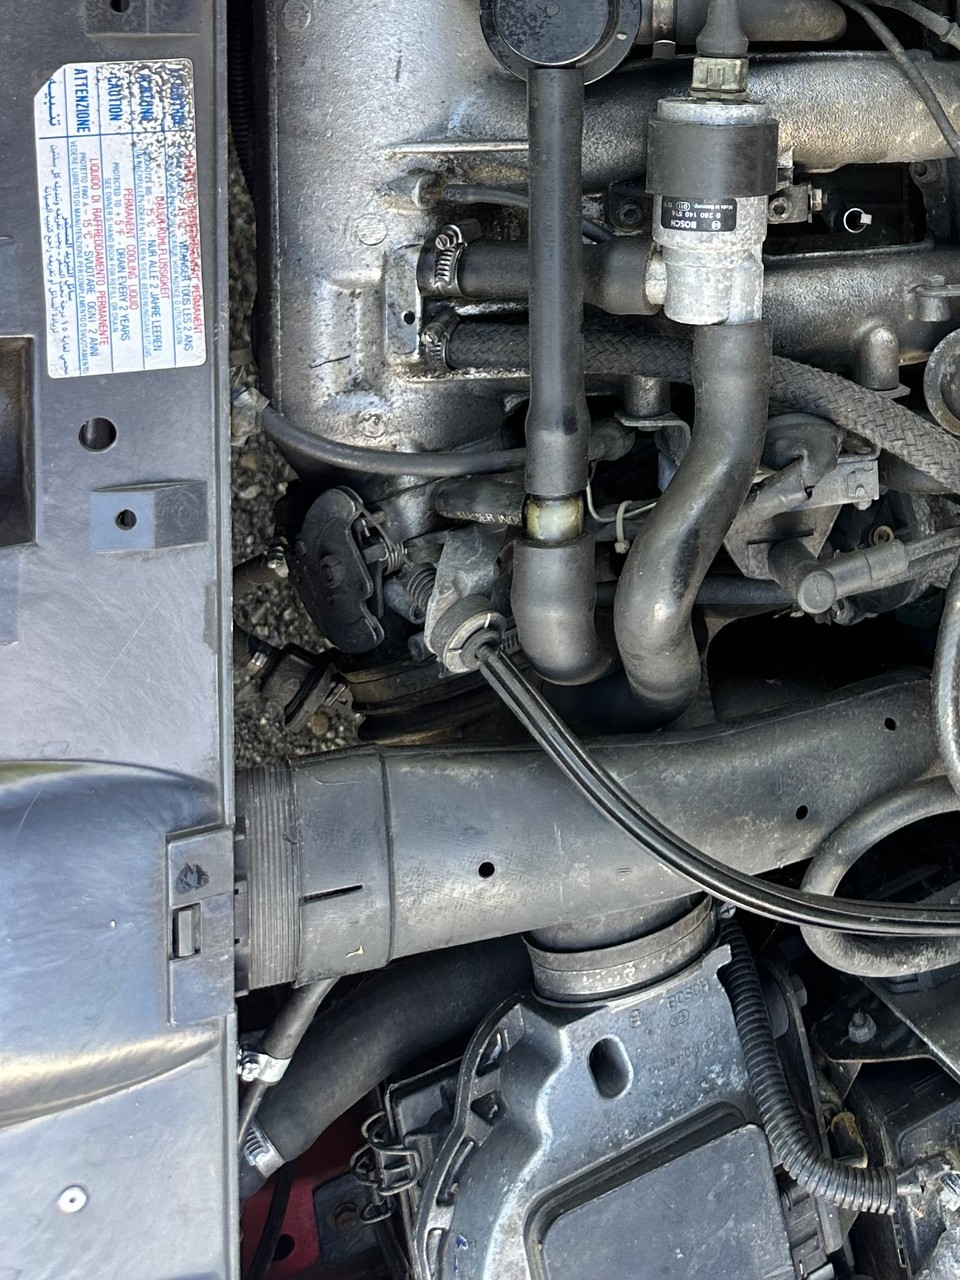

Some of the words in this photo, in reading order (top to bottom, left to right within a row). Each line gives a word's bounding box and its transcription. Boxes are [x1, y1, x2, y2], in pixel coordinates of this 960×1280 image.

[74, 68, 91, 133] ATTENZIONE
[107, 76, 123, 121] CAUTION
[70, 140, 79, 166] VEDERE
[80, 152, 89, 182] PROTETTO
[89, 158, 100, 190] LIQUIDO
[112, 162, 121, 196] PROTECTED
[114, 199, 121, 207] TO
[124, 188, 135, 239] PERMANENT
[62, 216, 73, 248] المستمر
[74, 208, 83, 259] MANUTENZIONE
[83, 218, 92, 228] 15
[670, 219, 697, 228] BOSCH
[92, 208, 106, 286] RAFFREDDAMENTO
[147, 240, 157, 257] NUR
[63, 251, 74, 277] التبريد
[84, 250, 95, 295] SVUOTARE
[116, 248, 127, 273] DRAIN
[126, 244, 138, 280] COOLING
[149, 260, 158, 280] ALLE
[65, 281, 75, 301] سائل
[77, 274, 86, 321] COMPLEMENTO
[118, 276, 128, 302] EVERY
[128, 284, 139, 310] LIQUID
[182, 285, 191, 305] TOUS
[88, 301, 97, 322] OGNI
[97, 290, 110, 346] PERMANENTE
[150, 292, 160, 318] JAHRE
[183, 308, 192, 323] LES
[120, 314, 130, 341] YEARS
[152, 321, 162, 351] LEEREN
[80, 329, 89, 374] SVUOTAMENTO
[89, 337, 99, 357] ANNI
[184, 334, 193, 351] ANS
[667, 978, 710, 1009] BOSCH
